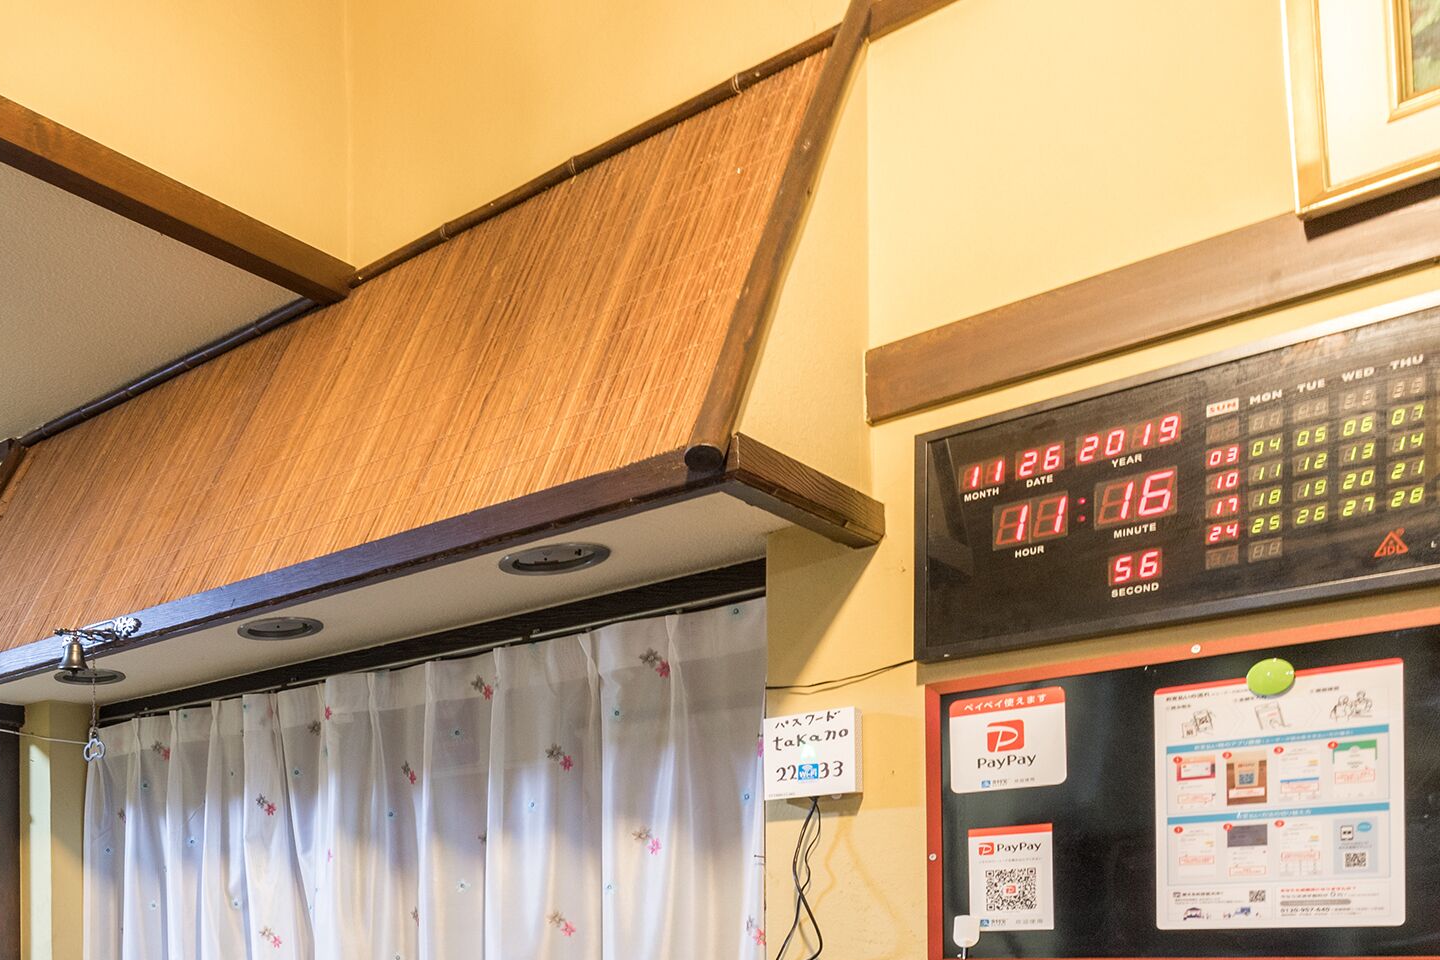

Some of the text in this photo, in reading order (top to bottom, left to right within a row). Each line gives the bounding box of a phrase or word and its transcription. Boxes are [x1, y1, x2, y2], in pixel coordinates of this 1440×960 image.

[1249, 389, 1282, 406] MON
[1296, 378, 1326, 393] TUE
[1342, 366, 1375, 382] WED
[1389, 353, 1424, 370] THU
[1018, 444, 1061, 477] 26
[1078, 414, 1179, 463] 2019
[1210, 403, 1425, 466] 03 04 05 06 07
[963, 453, 1143, 502] MONTH DATE YEAR
[1216, 432, 1424, 490] 10 11 12 13 14
[1215, 459, 1424, 515] 17 18 19 20 21
[1113, 522, 1157, 539] MINUTE
[1209, 487, 1424, 542] 24 25 26 27 28
[1014, 545, 1045, 559] HOUR
[1113, 550, 1159, 583] 56
[1111, 582, 1160, 598] SECOND
[964, 693, 1047, 711] ペイペイ使えます
[775, 710, 841, 729] パスワード
[977, 754, 1037, 769] PayPay
[996, 842, 1042, 853] PayPay
